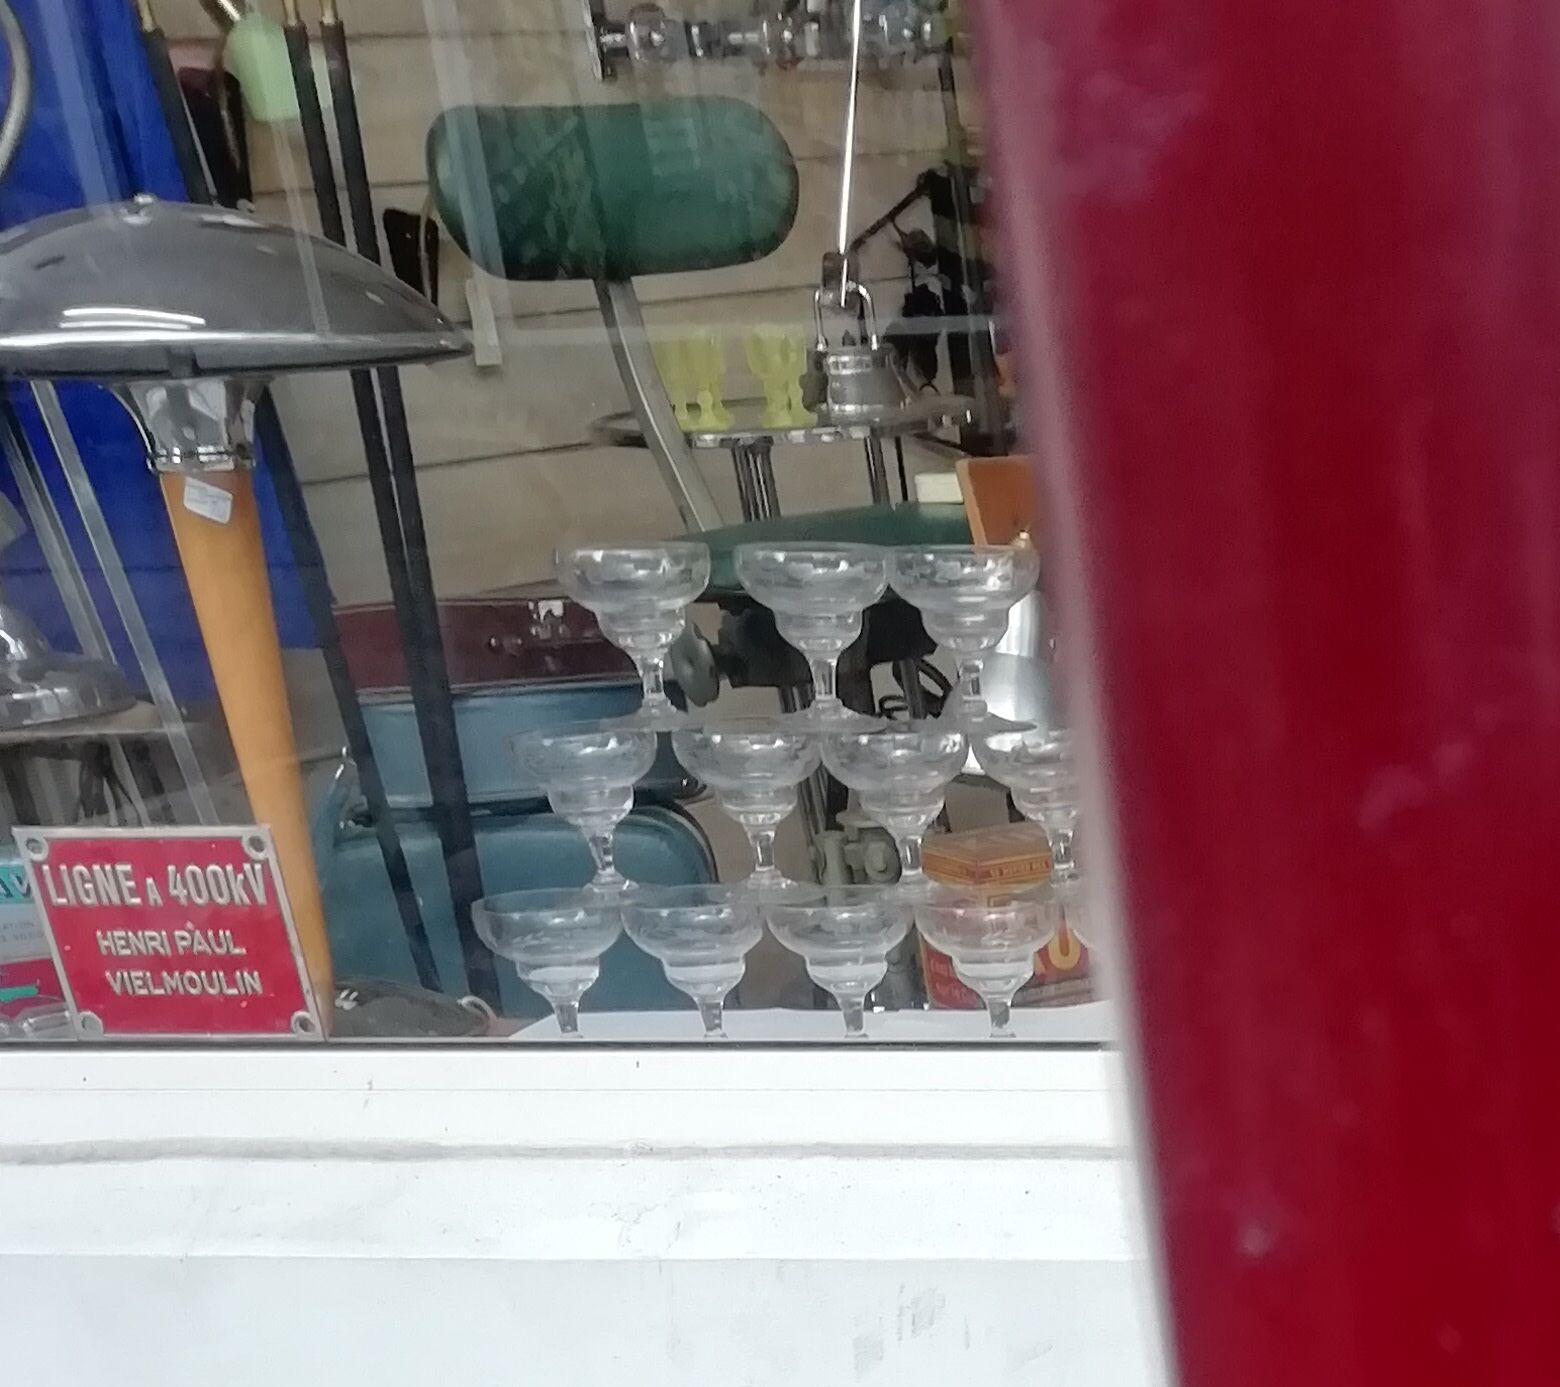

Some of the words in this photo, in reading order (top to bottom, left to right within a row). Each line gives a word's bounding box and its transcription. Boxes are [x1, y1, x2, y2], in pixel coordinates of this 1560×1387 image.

[42, 863, 142, 906] LIGNE
[167, 863, 267, 906] 400kV
[96, 928, 172, 956] HENRI
[105, 970, 264, 997] VIELMOULIN
